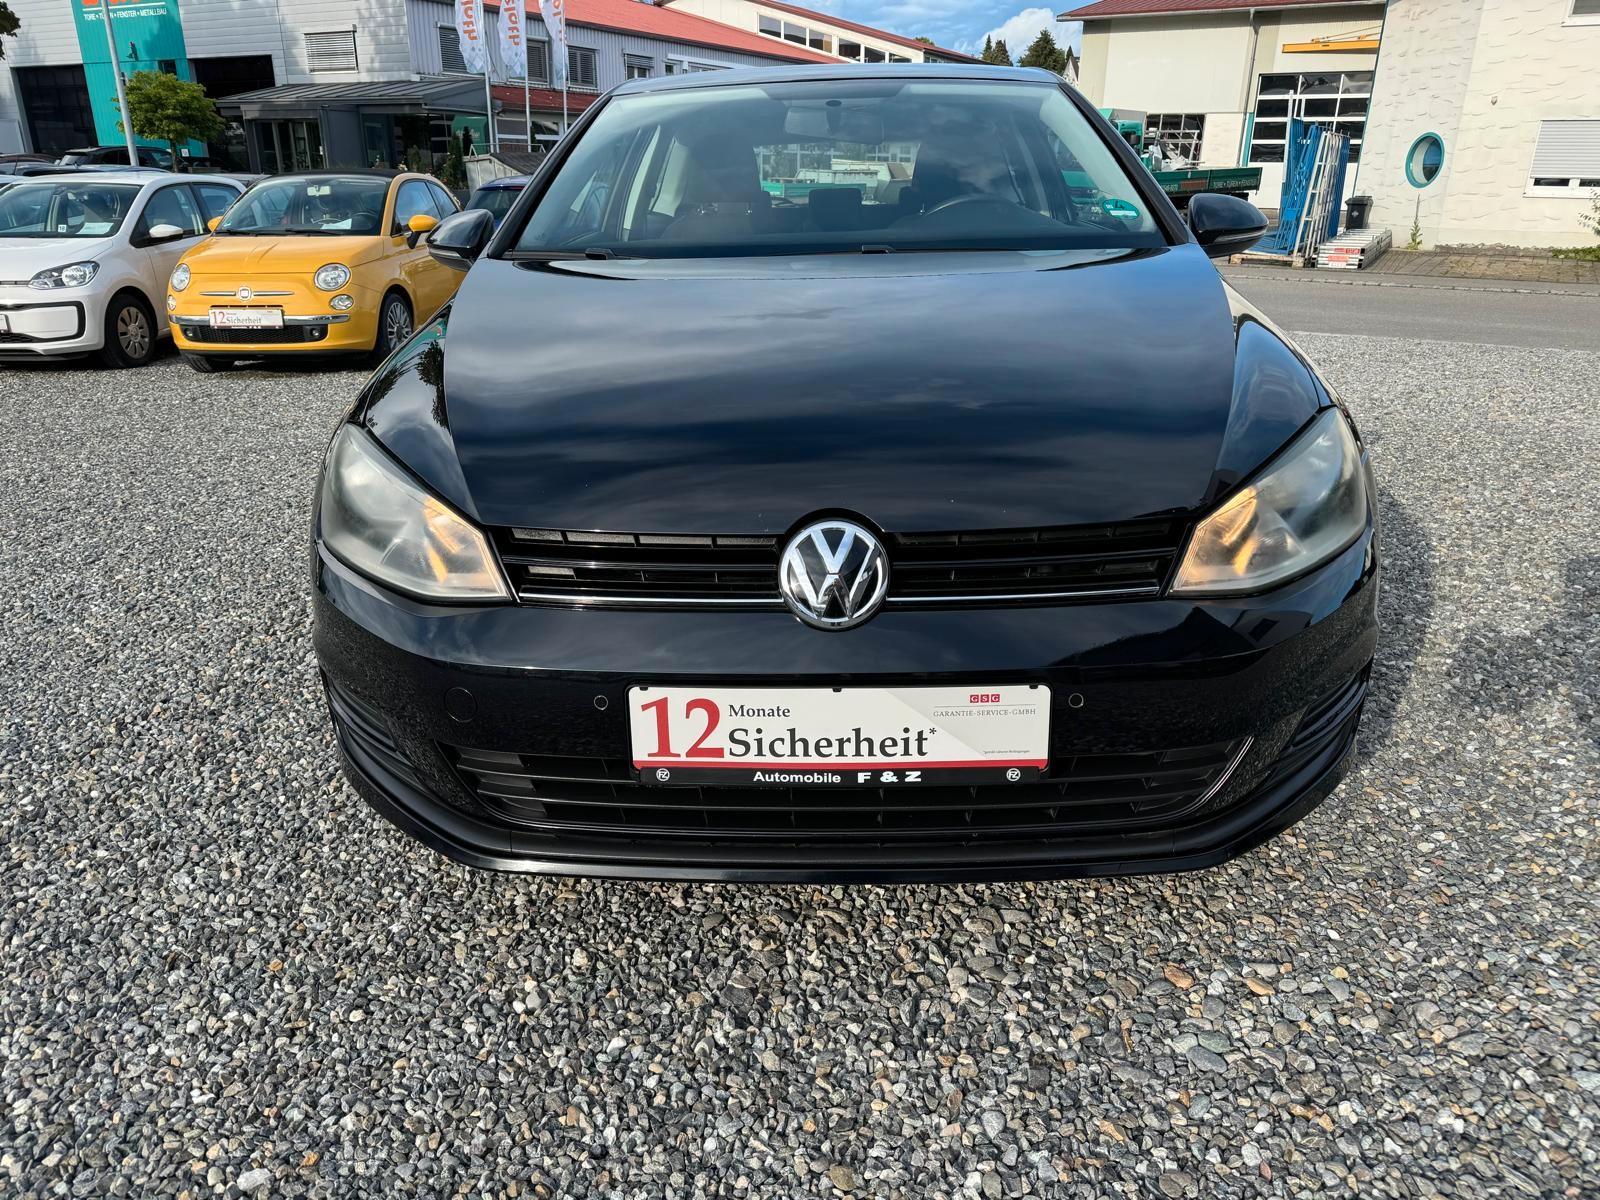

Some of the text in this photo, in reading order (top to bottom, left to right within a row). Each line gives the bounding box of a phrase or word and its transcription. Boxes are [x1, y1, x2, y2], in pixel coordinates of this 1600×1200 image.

[117, 10, 137, 18] FENSTER
[211, 311, 226, 324] 12
[728, 704, 791, 718] Monate
[641, 696, 725, 759] 12
[753, 771, 922, 784] Automobile F & Z
